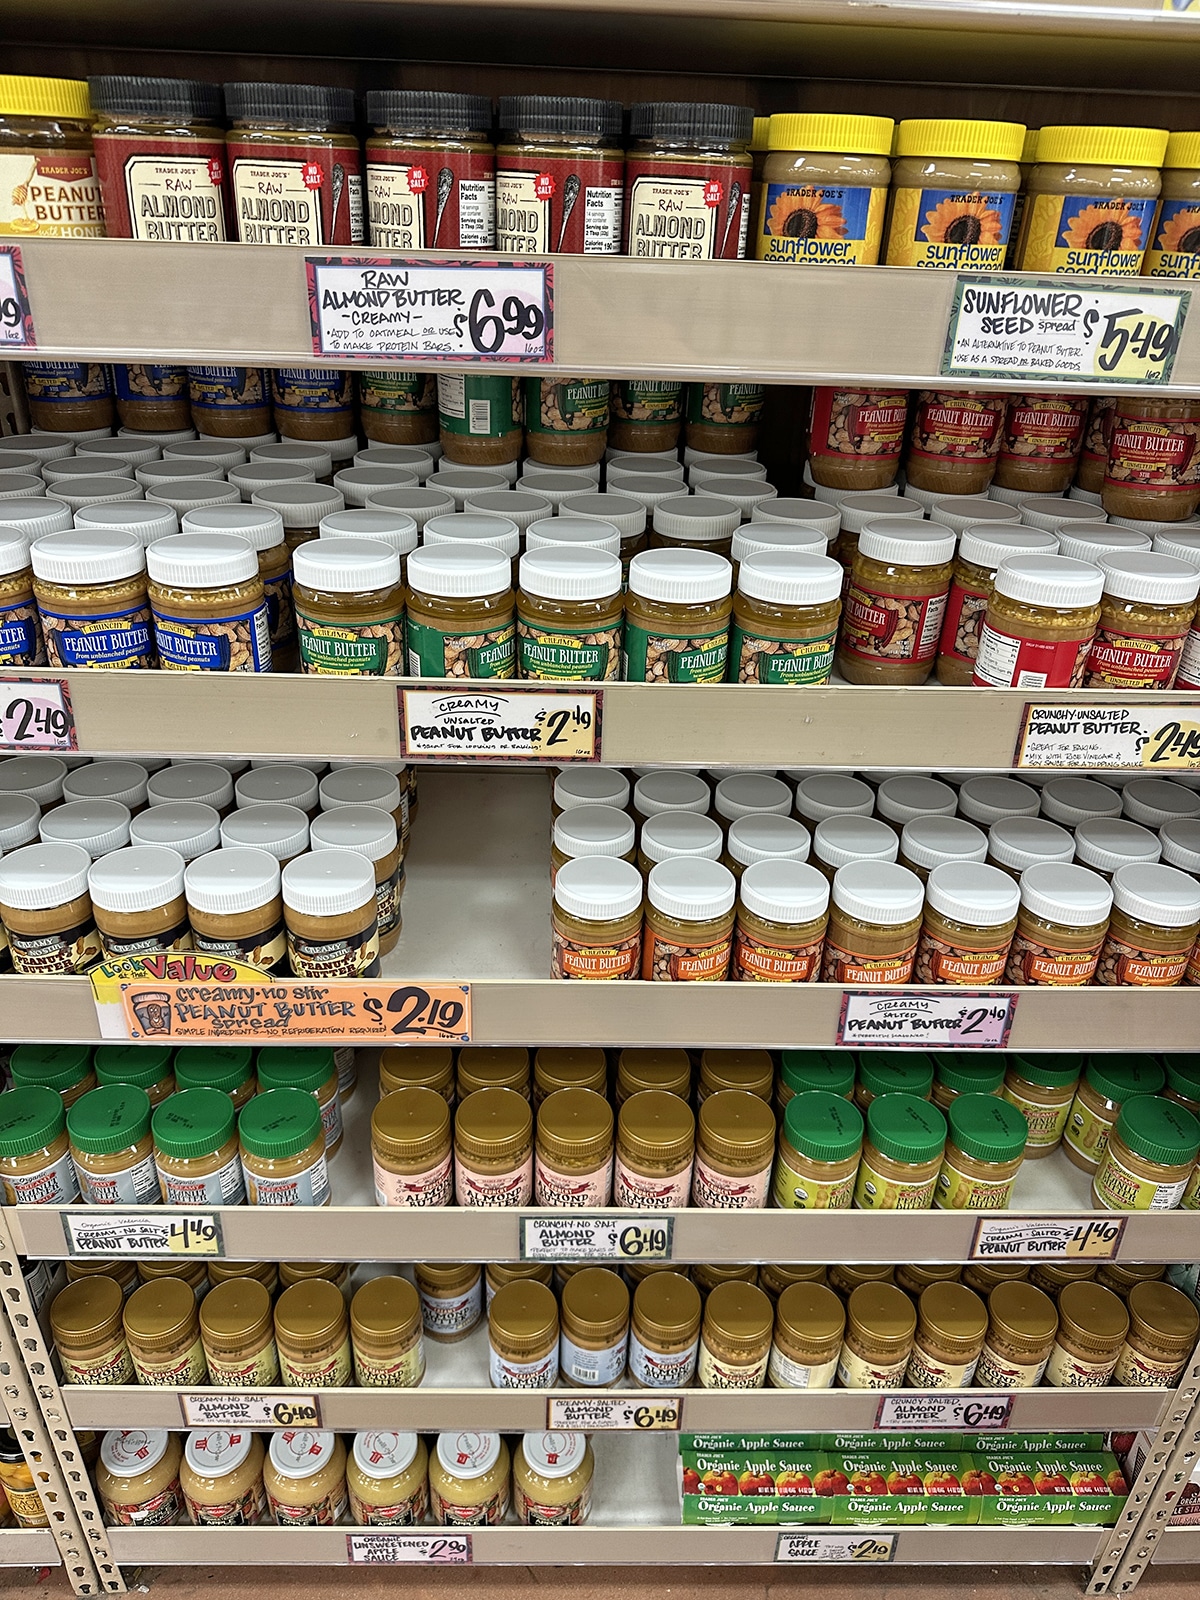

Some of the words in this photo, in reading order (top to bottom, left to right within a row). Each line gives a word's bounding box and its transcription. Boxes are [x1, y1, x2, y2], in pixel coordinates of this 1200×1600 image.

[165, 178, 192, 191] RAW
[305, 174, 321, 184] SALT
[411, 178, 425, 188] SALT
[258, 181, 282, 194] RAW
[538, 186, 552, 195] SALT
[786, 188, 817, 198] TRADER
[706, 192, 721, 201] SALT
[141, 195, 217, 219] ALMOND
[241, 198, 310, 223] ALMOND
[658, 199, 684, 212] RAW
[635, 214, 705, 239] ALMOND
[769, 237, 851, 257] sunflower
[926, 244, 1002, 262] sunflower
[1066, 250, 1141, 268] sunflower
[361, 270, 409, 289] RAW
[322, 289, 392, 310] ALMOND
[393, 289, 465, 306] BUTTER
[963, 288, 1083, 317] SUNFLOWER
[981, 316, 1035, 335] SEED
[1037, 319, 1078, 334] spread
[353, 329, 364, 338] TO
[369, 328, 421, 339] OATMEAL
[438, 328, 456, 337] USE
[343, 341, 373, 351] MAKE
[379, 342, 419, 351] PROTEIN
[972, 339, 1016, 351] ALTERNATIVE
[1027, 343, 1054, 356] PEANUT
[970, 354, 980, 363] AS
[990, 355, 1019, 366] SPREAD
[1029, 357, 1054, 369] BAKED
[1149, 436, 1184, 452] BUTTER
[64, 634, 108, 652] PEANUT
[111, 628, 149, 649] BUTTER
[174, 637, 217, 656] BUTTER
[334, 640, 376, 657] BUTTER
[523, 643, 558, 662] PEANUT
[560, 650, 599, 665] BUTTER
[771, 655, 811, 671] PEANUT
[1092, 645, 1132, 664] PEANUT
[1133, 652, 1172, 668] BUTTER
[1031, 709, 1075, 720] CRUNCHY
[1078, 709, 1130, 721] UNSALTED
[410, 725, 477, 741] PEANUT
[481, 727, 542, 742] BUTTER
[1028, 722, 1081, 736] PEANUT
[1083, 721, 1142, 736] BUTTER
[16, 952, 68, 966] PEANUT
[564, 954, 597, 970] PEANUT
[599, 953, 631, 970] BUTTER
[741, 950, 772, 970] PEANUT
[774, 956, 807, 972] BUTTER
[23, 960, 74, 974] BUTTER
[100, 956, 146, 978] Look
[142, 955, 237, 982] Value
[942, 960, 979, 976] PEANUT
[1035, 960, 1073, 976] PEANUT
[1128, 963, 1168, 978] PEANUT
[846, 967, 883, 983] PEANUT
[176, 986, 255, 1004] creamy
[264, 986, 288, 999] no
[293, 986, 329, 1000] stir
[174, 1002, 267, 1023] PEANUT
[274, 1000, 355, 1018] BUTTER
[212, 1015, 290, 1030] spread
[848, 1019, 908, 1031] PEANUT
[912, 1018, 961, 1030] BUTTER
[175, 1028, 206, 1036] SIMPLE
[281, 1027, 345, 1035] REFRIGERATION
[533, 1220, 574, 1229] CRUNCHY
[577, 1220, 591, 1228] NO
[594, 1220, 618, 1228] SALT
[539, 1229, 596, 1239] ALMOND
[75, 1237, 124, 1250] PEANUT
[128, 1236, 169, 1248] BUTTER
[542, 1238, 596, 1248] BUTTER
[979, 1241, 1025, 1254] PEANUT
[1028, 1240, 1067, 1252] BUTTER
[198, 1403, 250, 1411] ALMOND
[894, 1405, 946, 1413] ALMOND
[203, 1411, 251, 1419] BUTTER
[693, 1439, 735, 1450] Organic
[738, 1438, 770, 1450] Apple
[773, 1439, 804, 1448] Sauce
[835, 1438, 876, 1450] Organic
[879, 1438, 911, 1450] Apple
[914, 1439, 945, 1448] Sauce
[976, 1440, 1018, 1451] Organic
[1020, 1440, 1055, 1451] Apple
[1057, 1440, 1086, 1450] Sauce
[697, 1459, 740, 1475] Organic
[743, 1460, 776, 1476] Apple
[779, 1460, 812, 1472] Sauce
[843, 1460, 886, 1475] Organic
[890, 1460, 923, 1475] Apple
[924, 1460, 958, 1472] Sauce
[988, 1461, 1032, 1476] Organic
[1035, 1461, 1067, 1476] Apple
[1069, 1462, 1103, 1472] Sauce
[698, 1501, 742, 1514] Organic
[745, 1502, 779, 1514] Apple
[782, 1502, 815, 1512] Sauce
[848, 1502, 891, 1514] Organic
[894, 1501, 928, 1514] Apple
[931, 1502, 964, 1512] Sauce
[996, 1501, 1039, 1514] Organic
[1042, 1502, 1076, 1514] Apple
[1079, 1502, 1112, 1512] Sauce
[353, 1541, 429, 1549] UNSWEETENED
[789, 1540, 820, 1548] APPLE
